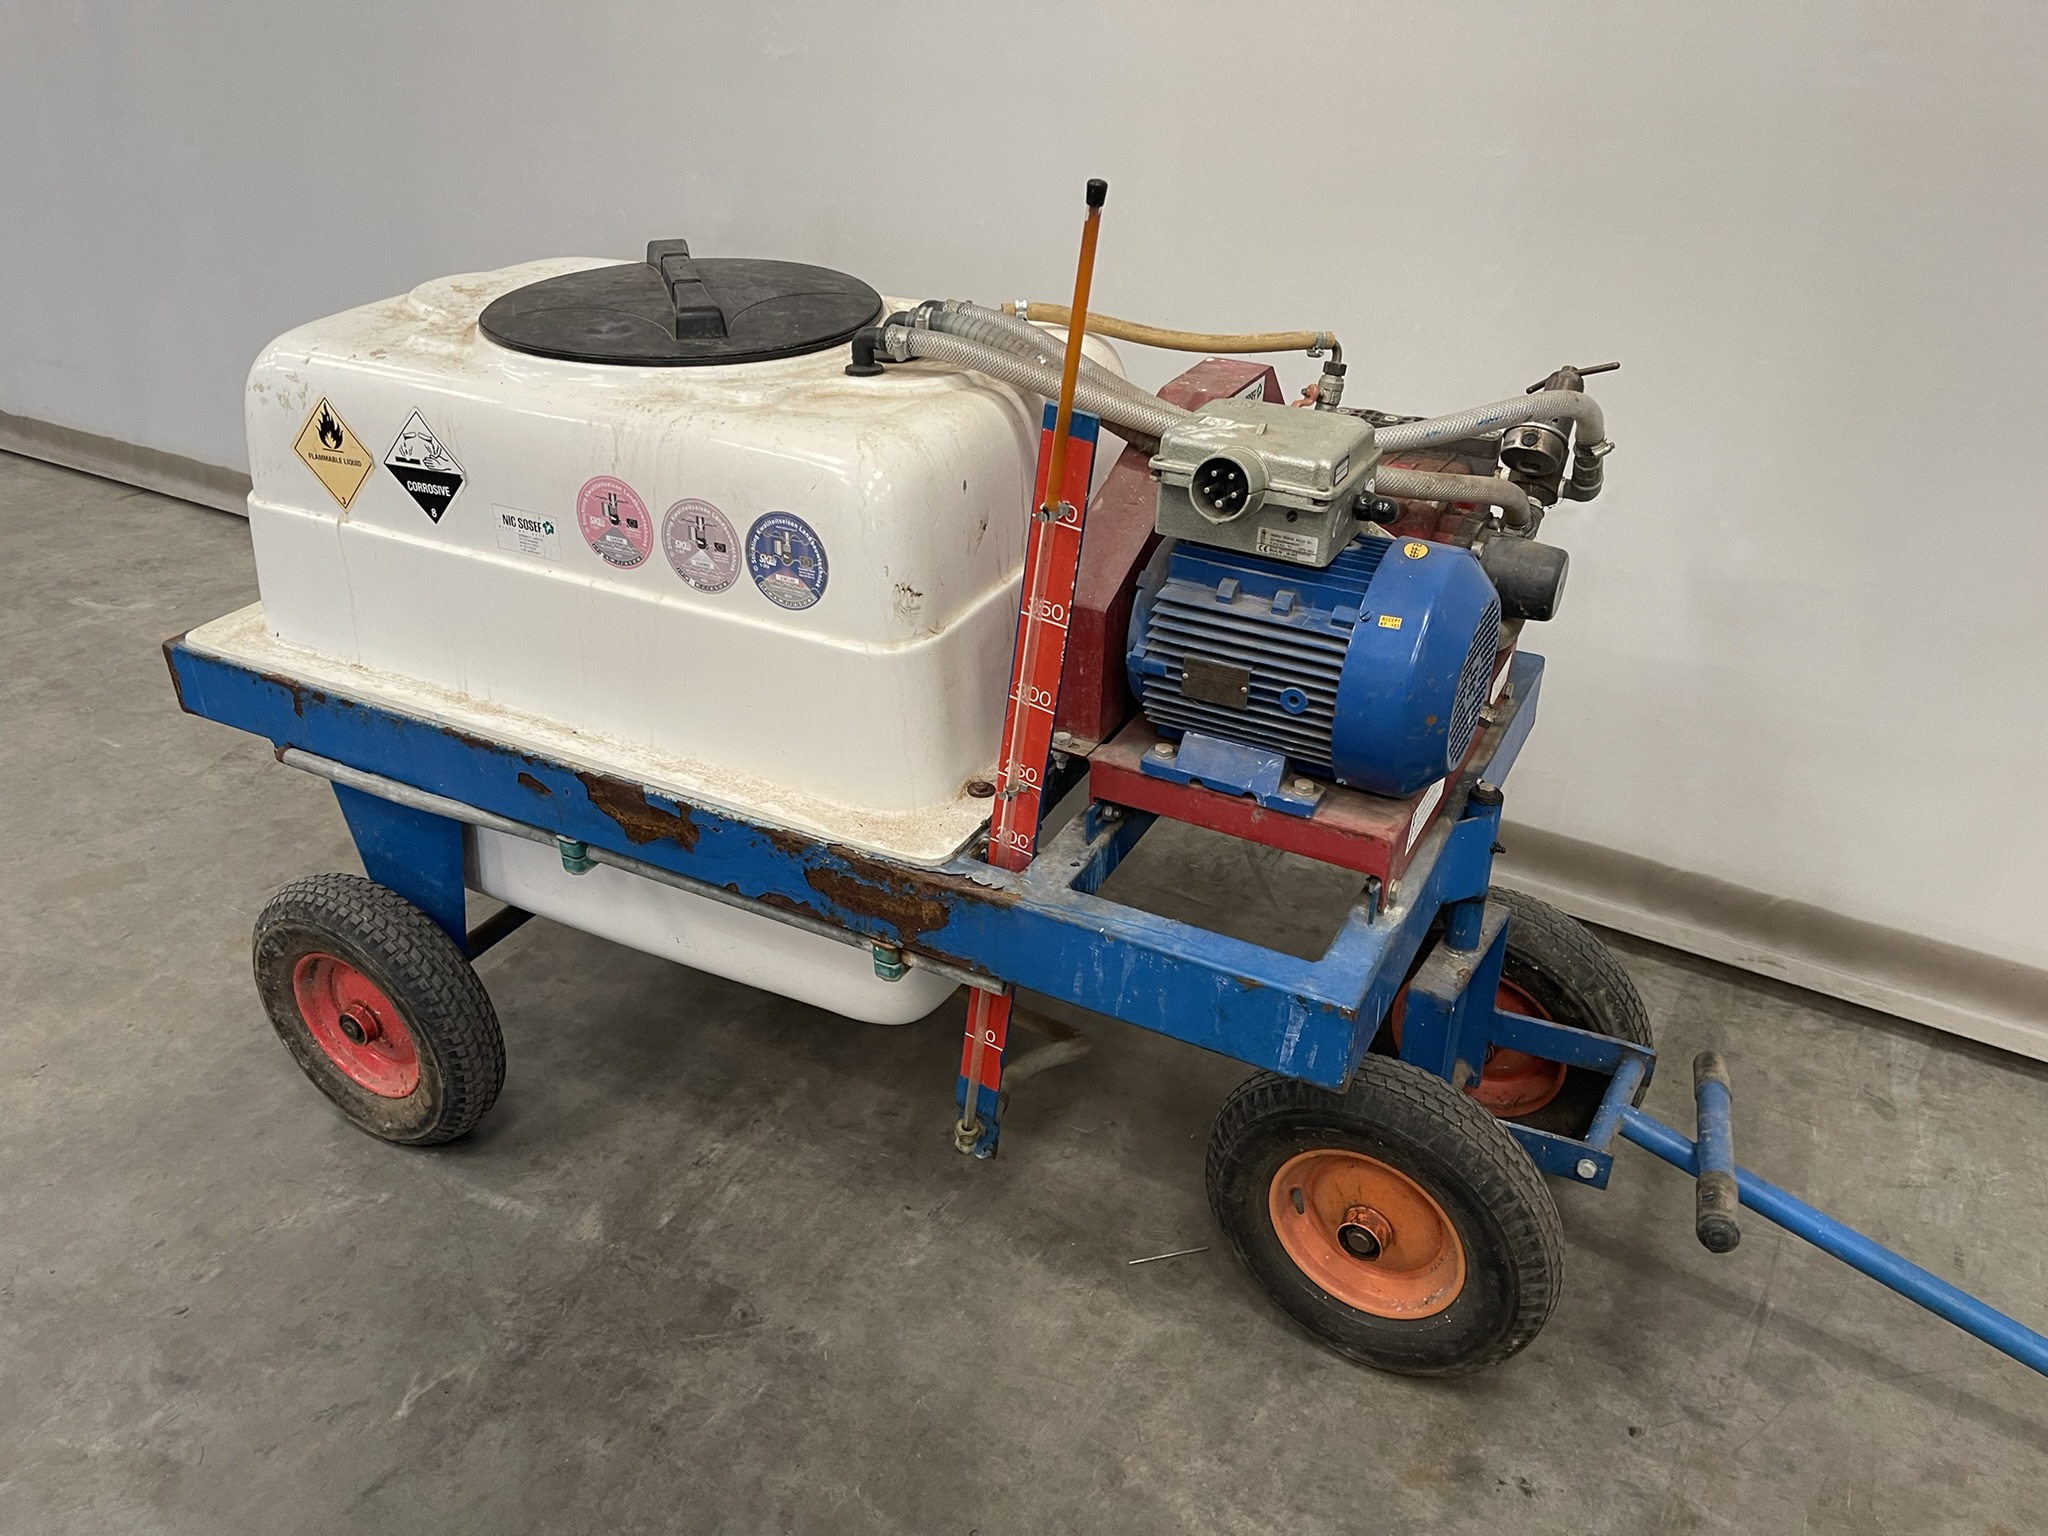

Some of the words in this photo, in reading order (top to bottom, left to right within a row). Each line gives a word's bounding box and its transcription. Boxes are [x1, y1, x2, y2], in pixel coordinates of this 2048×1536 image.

[308, 453, 342, 465] FLAMMABLE
[343, 458, 362, 467] LIQUID
[406, 480, 451, 497] CORROSIVE
[431, 508, 438, 518] 8
[502, 514, 516, 527] NIC
[517, 518, 541, 533] SOSEF
